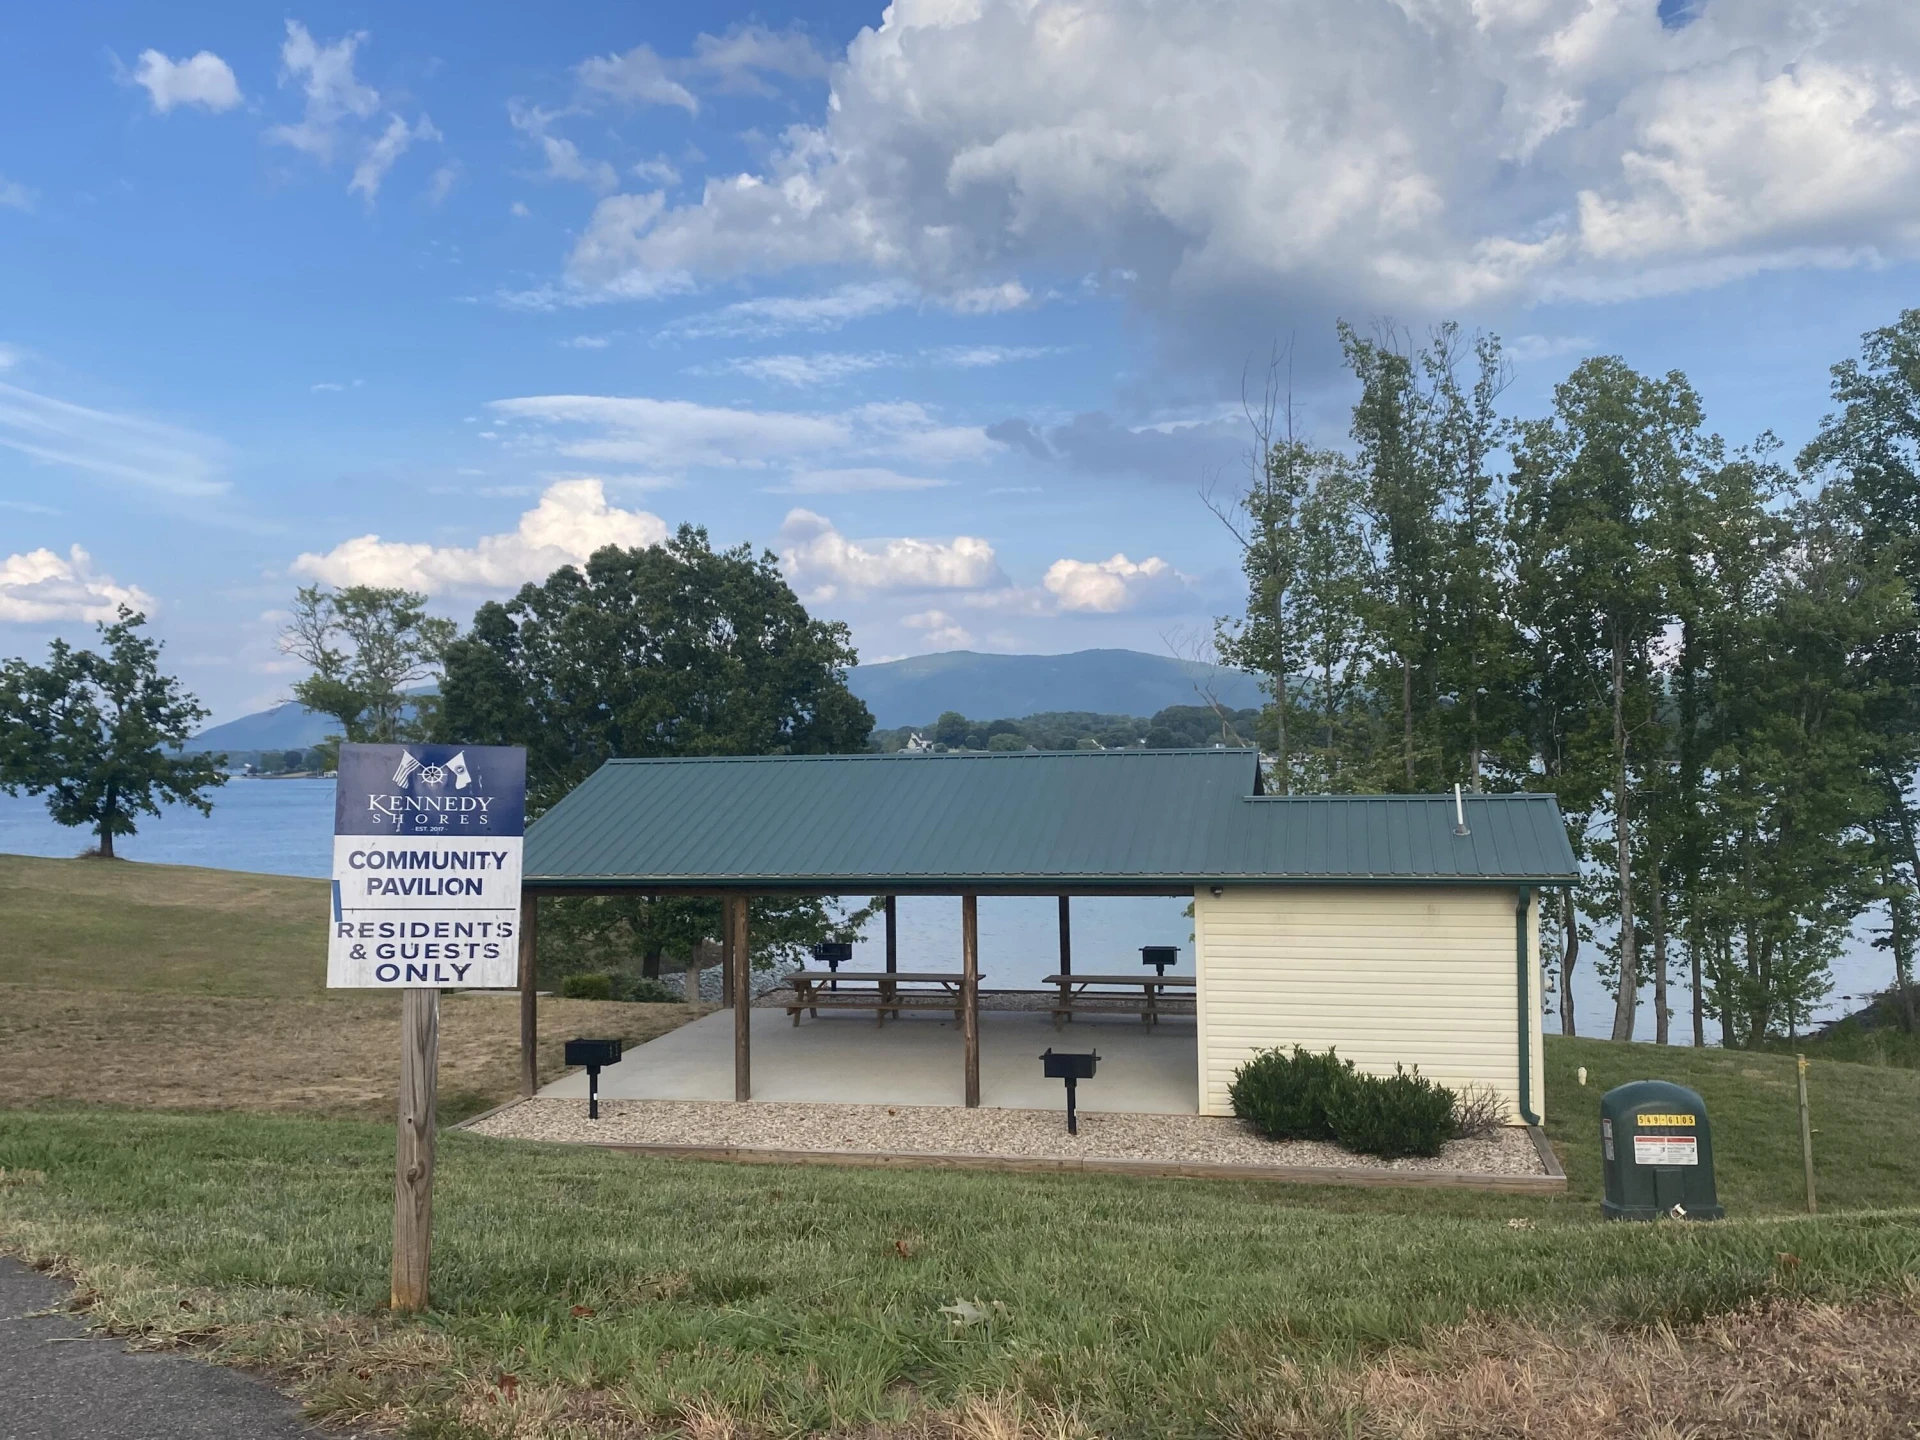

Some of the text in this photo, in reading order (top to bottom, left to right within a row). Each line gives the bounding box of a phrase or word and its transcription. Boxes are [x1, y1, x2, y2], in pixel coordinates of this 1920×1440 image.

[367, 794, 495, 815] KENNEDY
[372, 813, 488, 825] SHORES
[348, 850, 508, 870] COMMUNITY
[366, 877, 483, 896] PAVILION
[337, 922, 513, 939] RESIDENTS
[349, 943, 500, 960] & GUESTS
[375, 963, 472, 982] ONLY
